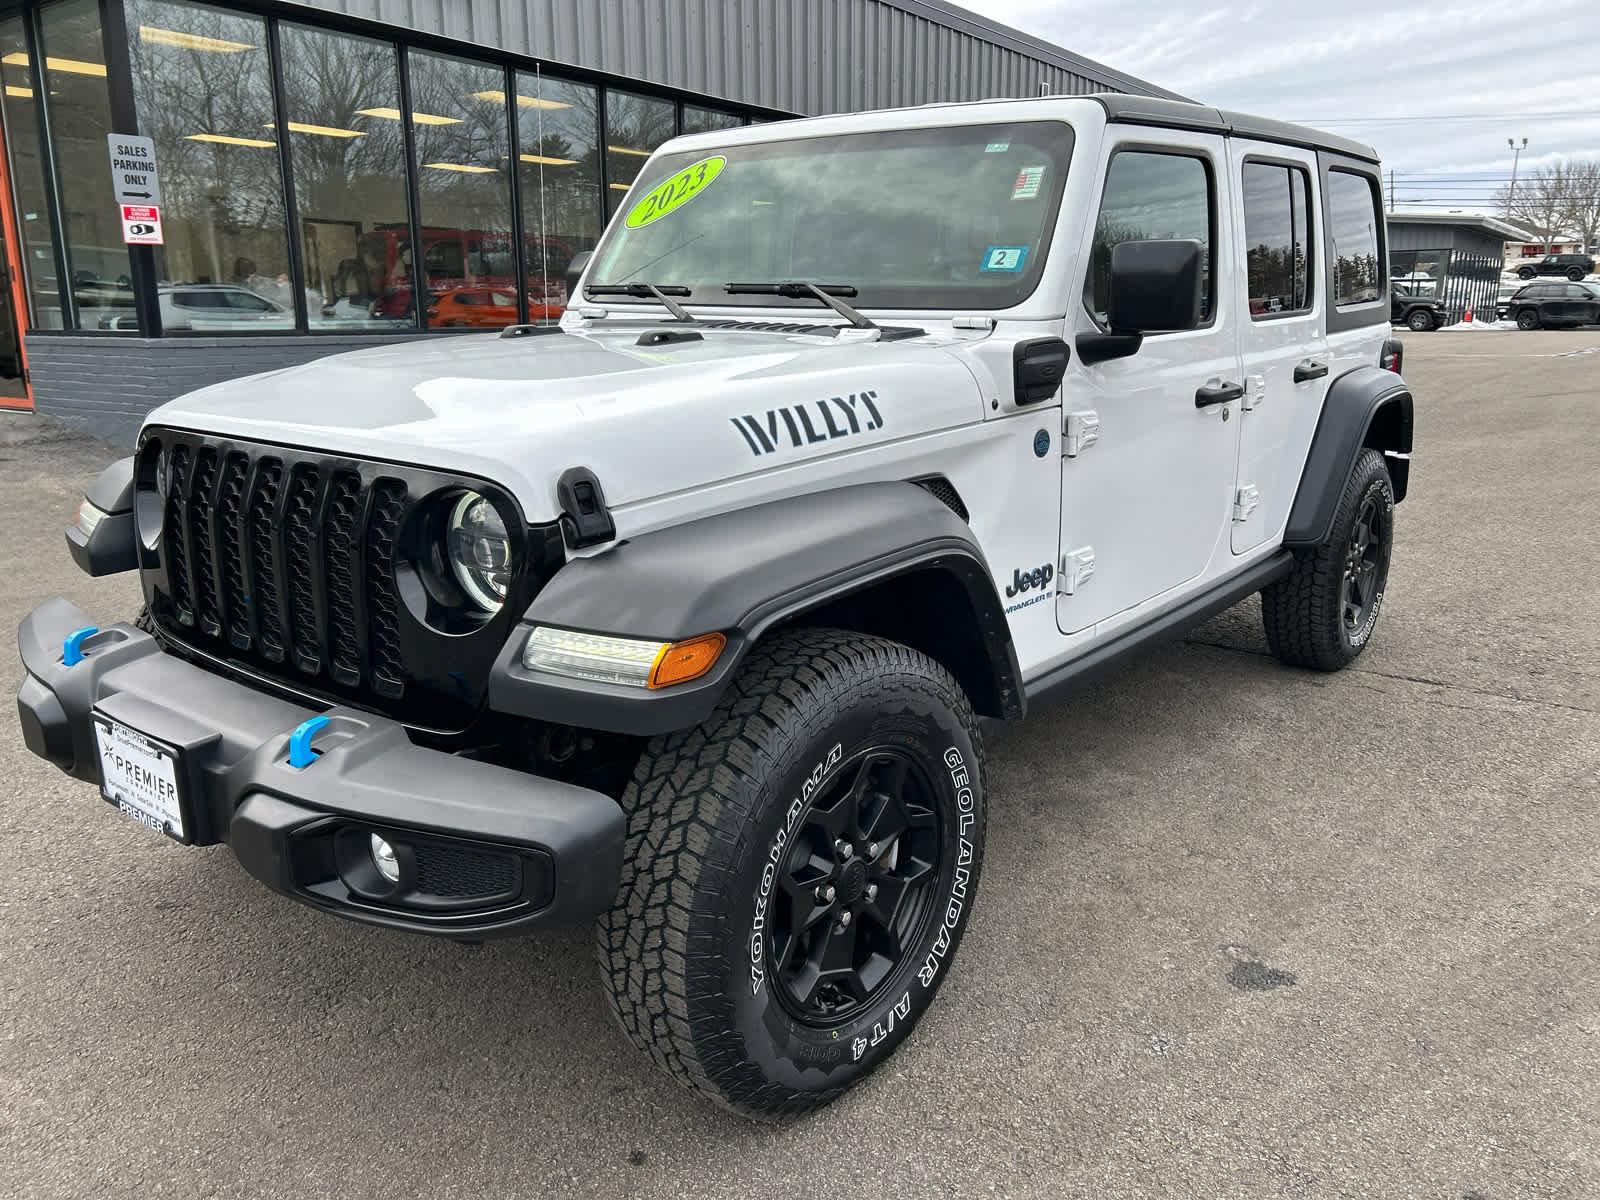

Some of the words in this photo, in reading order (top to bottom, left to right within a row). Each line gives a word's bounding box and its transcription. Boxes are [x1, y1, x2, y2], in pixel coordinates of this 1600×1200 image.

[113, 158, 155, 172] PARKING
[117, 144, 148, 157] SALES
[124, 174, 148, 186] ONLY
[640, 163, 708, 224] 2023
[994, 251, 1007, 266] 2
[729, 390, 885, 457] WILLYS
[1005, 562, 1054, 598] Jeep
[115, 755, 175, 801] PREMIER
[120, 800, 165, 835] PREMIER
[751, 743, 843, 995] YOKOHAMA
[918, 747, 974, 988] GEOLANDAR
